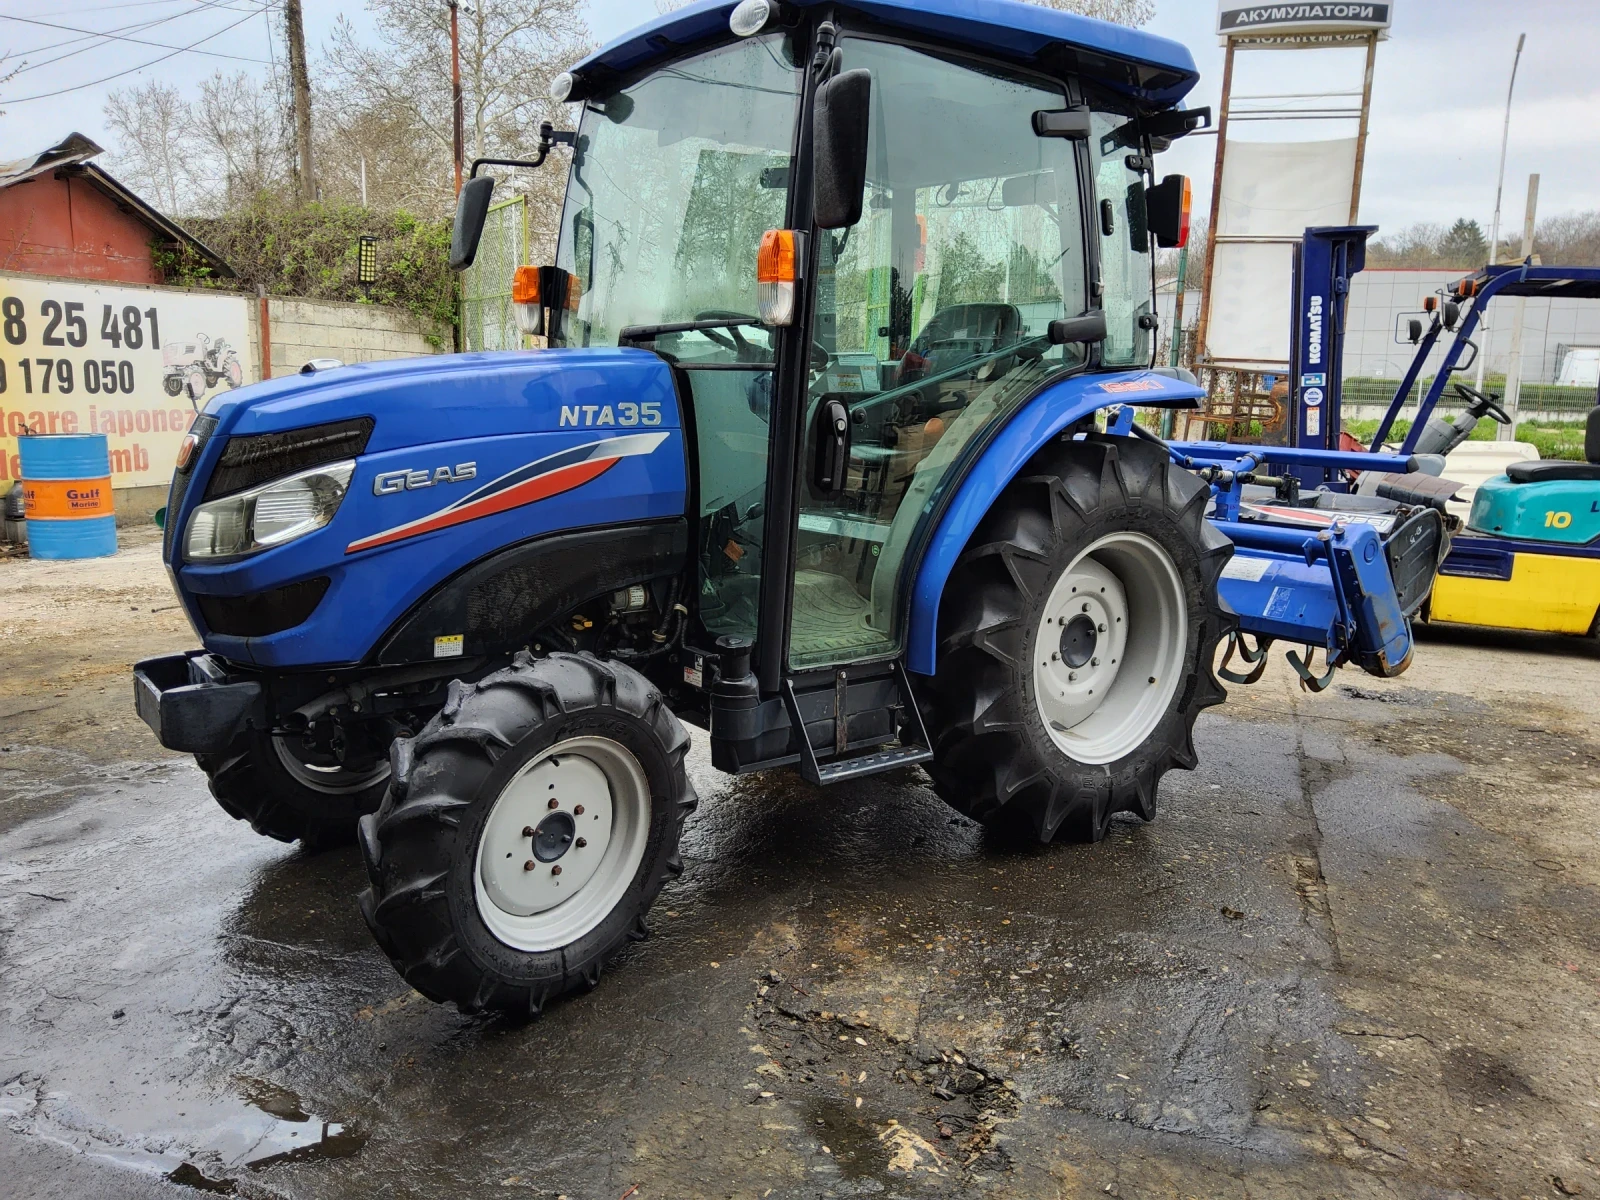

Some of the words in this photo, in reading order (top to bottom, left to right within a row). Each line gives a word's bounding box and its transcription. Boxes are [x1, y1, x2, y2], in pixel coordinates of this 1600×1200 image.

[1236, 5, 1373, 23] АКУМУЛАТОРИ
[2, 296, 27, 345] 8
[41, 299, 87, 348] 25
[100, 304, 160, 350] 481
[1307, 295, 1323, 364] KOMATSU
[18, 358, 74, 394] 179
[83, 359, 135, 394] 050
[1097, 380, 1164, 393] ISEKI
[373, 461, 477, 496] GEAS
[66, 489, 100, 499] Gulf
[1544, 511, 1572, 529] 10
